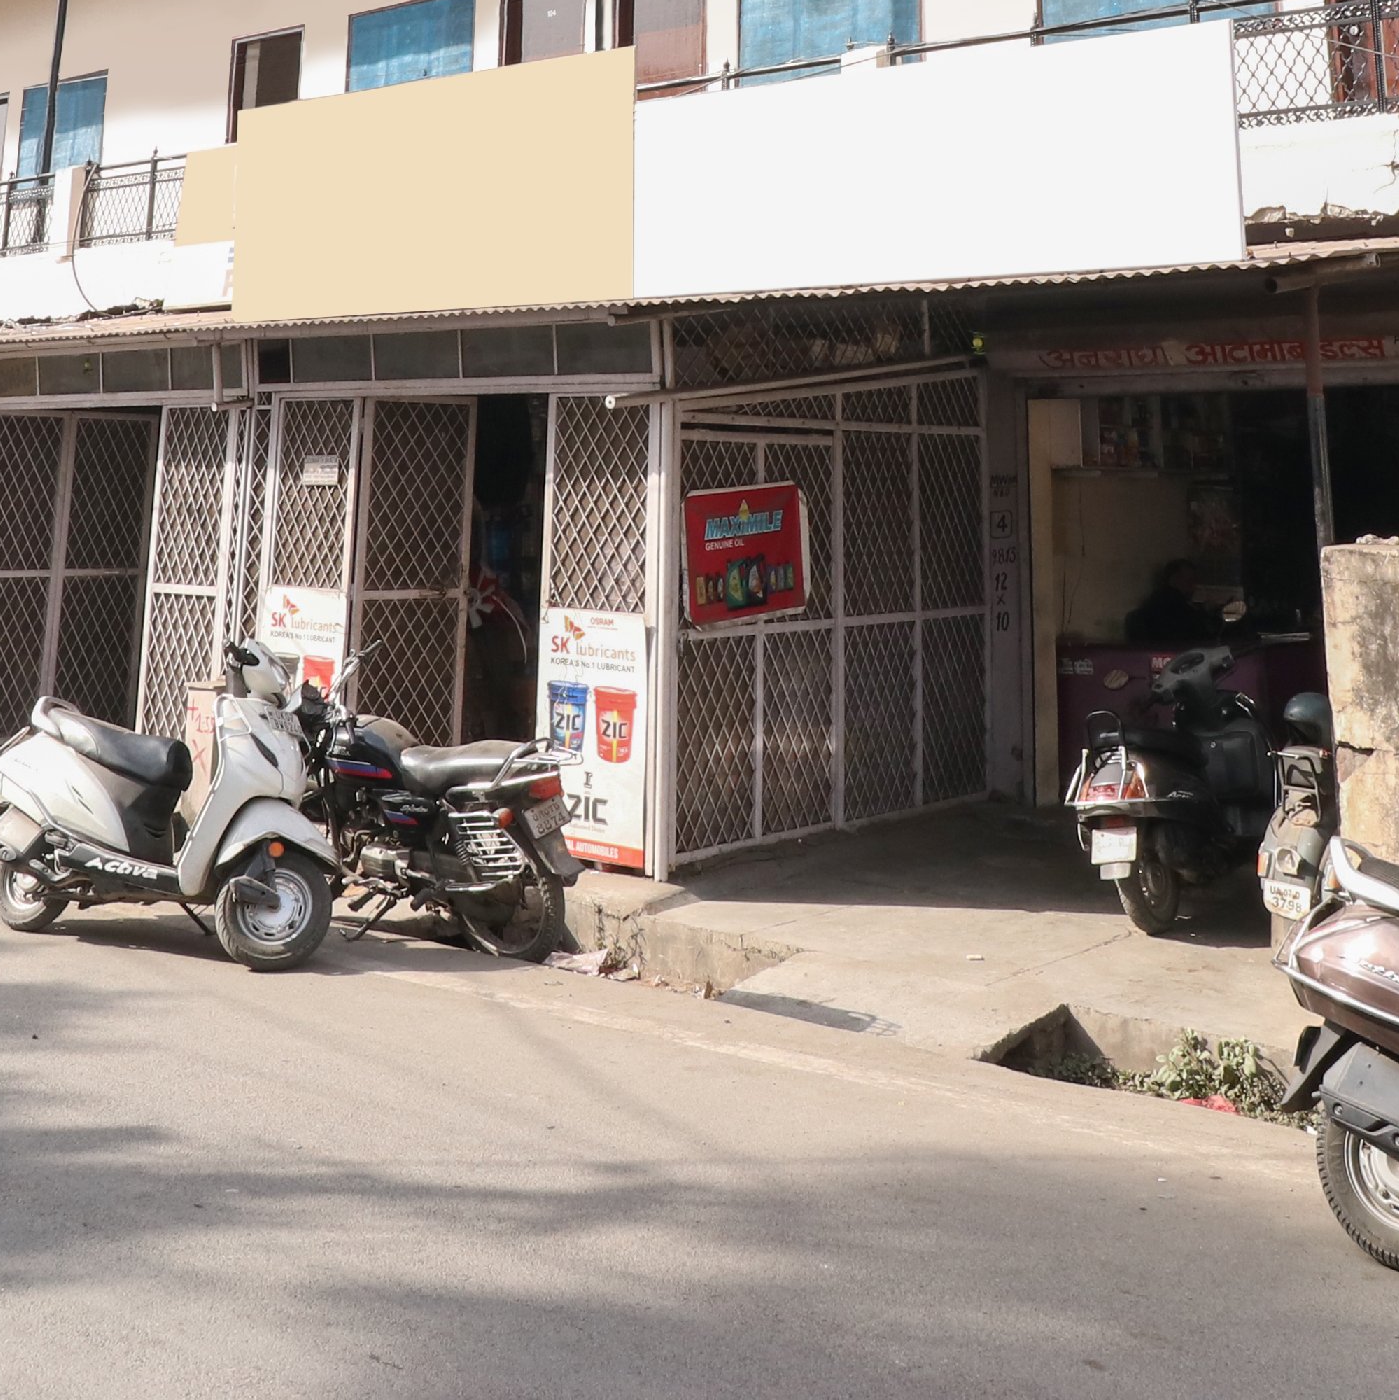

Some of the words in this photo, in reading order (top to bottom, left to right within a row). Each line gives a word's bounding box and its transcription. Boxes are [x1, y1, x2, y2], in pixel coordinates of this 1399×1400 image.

[997, 514, 1007, 532] 4
[705, 540, 733, 551] GENUINE
[734, 539, 745, 548] OIL
[995, 572, 1007, 591] 12
[271, 612, 287, 628] SK
[291, 614, 337, 632] lubricants
[996, 611, 1009, 631] 10
[551, 635, 570, 654] SK
[576, 641, 637, 662] lubricants
[596, 662, 635, 673] LUBRICANT
[555, 711, 580, 731] ZIC
[601, 718, 628, 739] ZIC
[567, 793, 608, 826] ZIC
[84, 857, 158, 879] Activa
[1271, 896, 1301, 913] 3798
